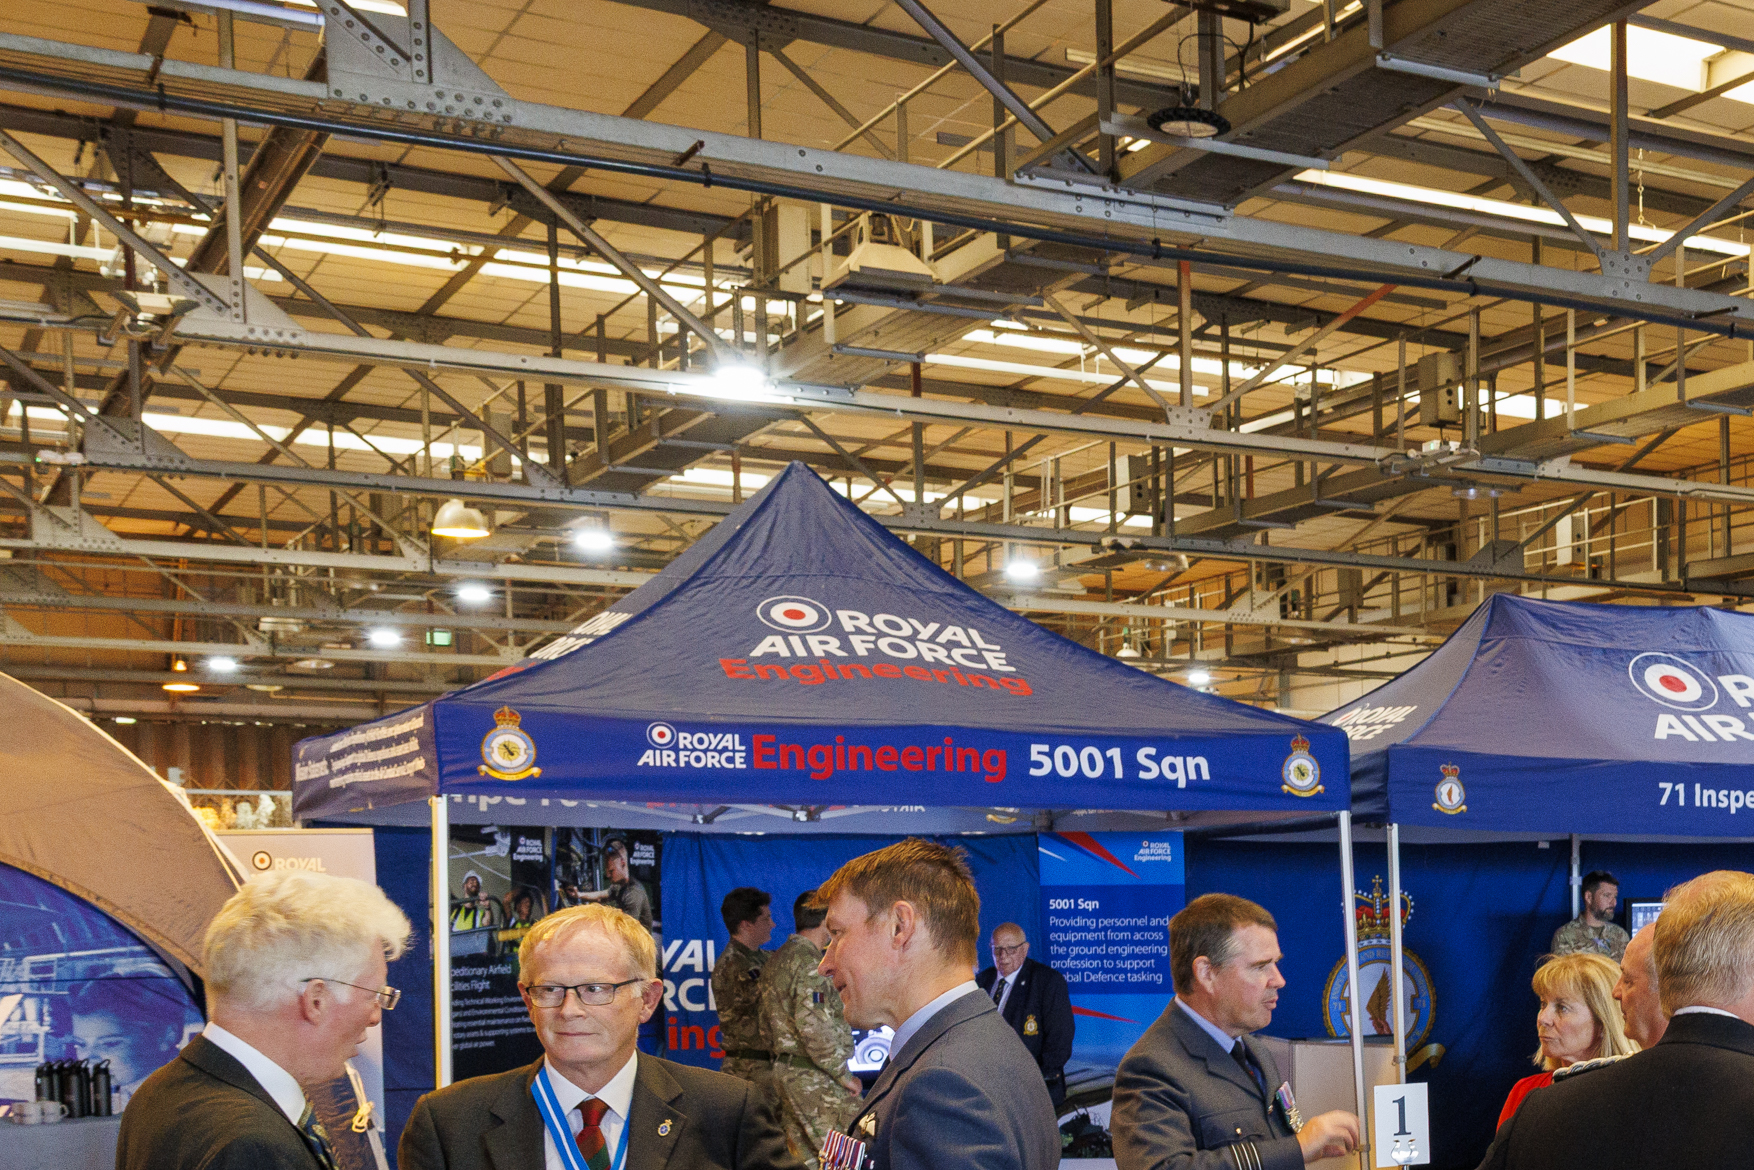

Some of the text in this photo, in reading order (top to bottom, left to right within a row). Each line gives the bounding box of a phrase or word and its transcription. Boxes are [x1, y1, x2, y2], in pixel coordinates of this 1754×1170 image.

[836, 610, 1001, 650] ROYAL
[750, 635, 1016, 672] AIR FORCE
[719, 658, 1033, 696] Engineering
[677, 732, 746, 751] ROYAL
[637, 735, 1210, 788] AIR FORCE Engineering 5001 Sqn
[1658, 782, 1685, 807] 71
[275, 857, 326, 872] ROYAL
[1134, 854, 1171, 862] Engineering
[1049, 898, 1099, 911] 5001 Sqn
[1050, 915, 1169, 929] Providing personnel and
[1050, 929, 1164, 943] equipment from across
[1050, 944, 1168, 957] the ground engineering
[1051, 958, 1155, 970] profession to support
[1084, 971, 1126, 983] Defence
[1127, 971, 1163, 984] tasking
[1392, 1095, 1412, 1136] 1
